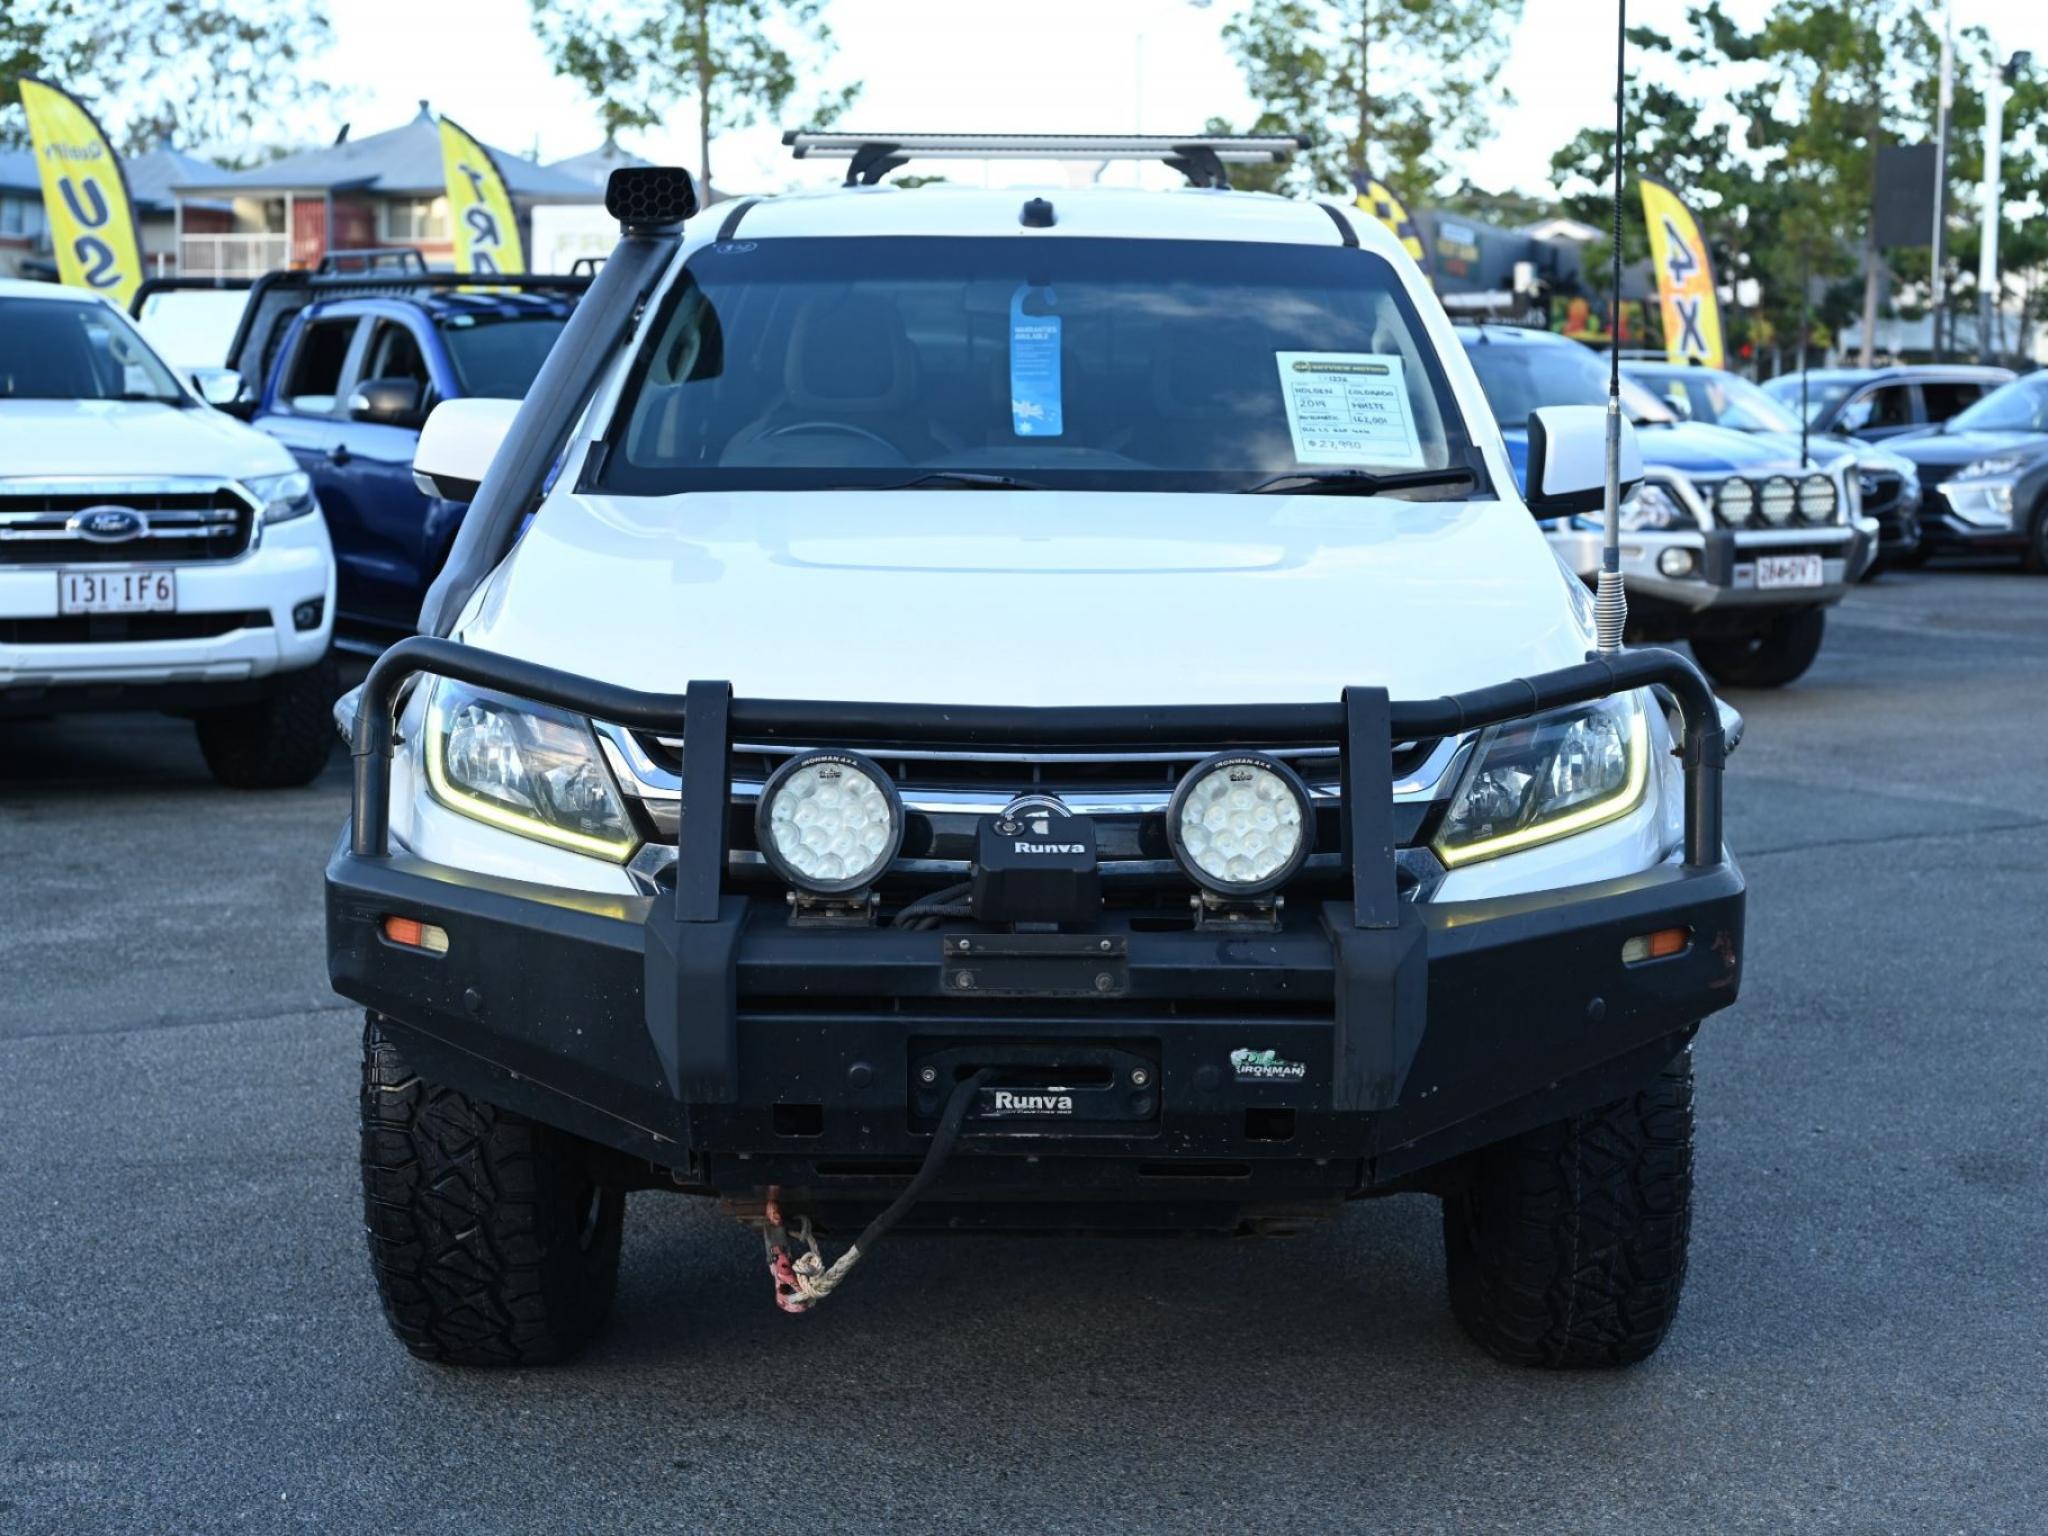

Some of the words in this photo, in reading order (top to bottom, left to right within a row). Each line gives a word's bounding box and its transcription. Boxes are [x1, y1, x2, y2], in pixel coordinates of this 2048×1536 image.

[1015, 841, 1085, 853] Runva
[1240, 1063, 1301, 1075] IRONMAN
[995, 1092, 1072, 1109] Runva
